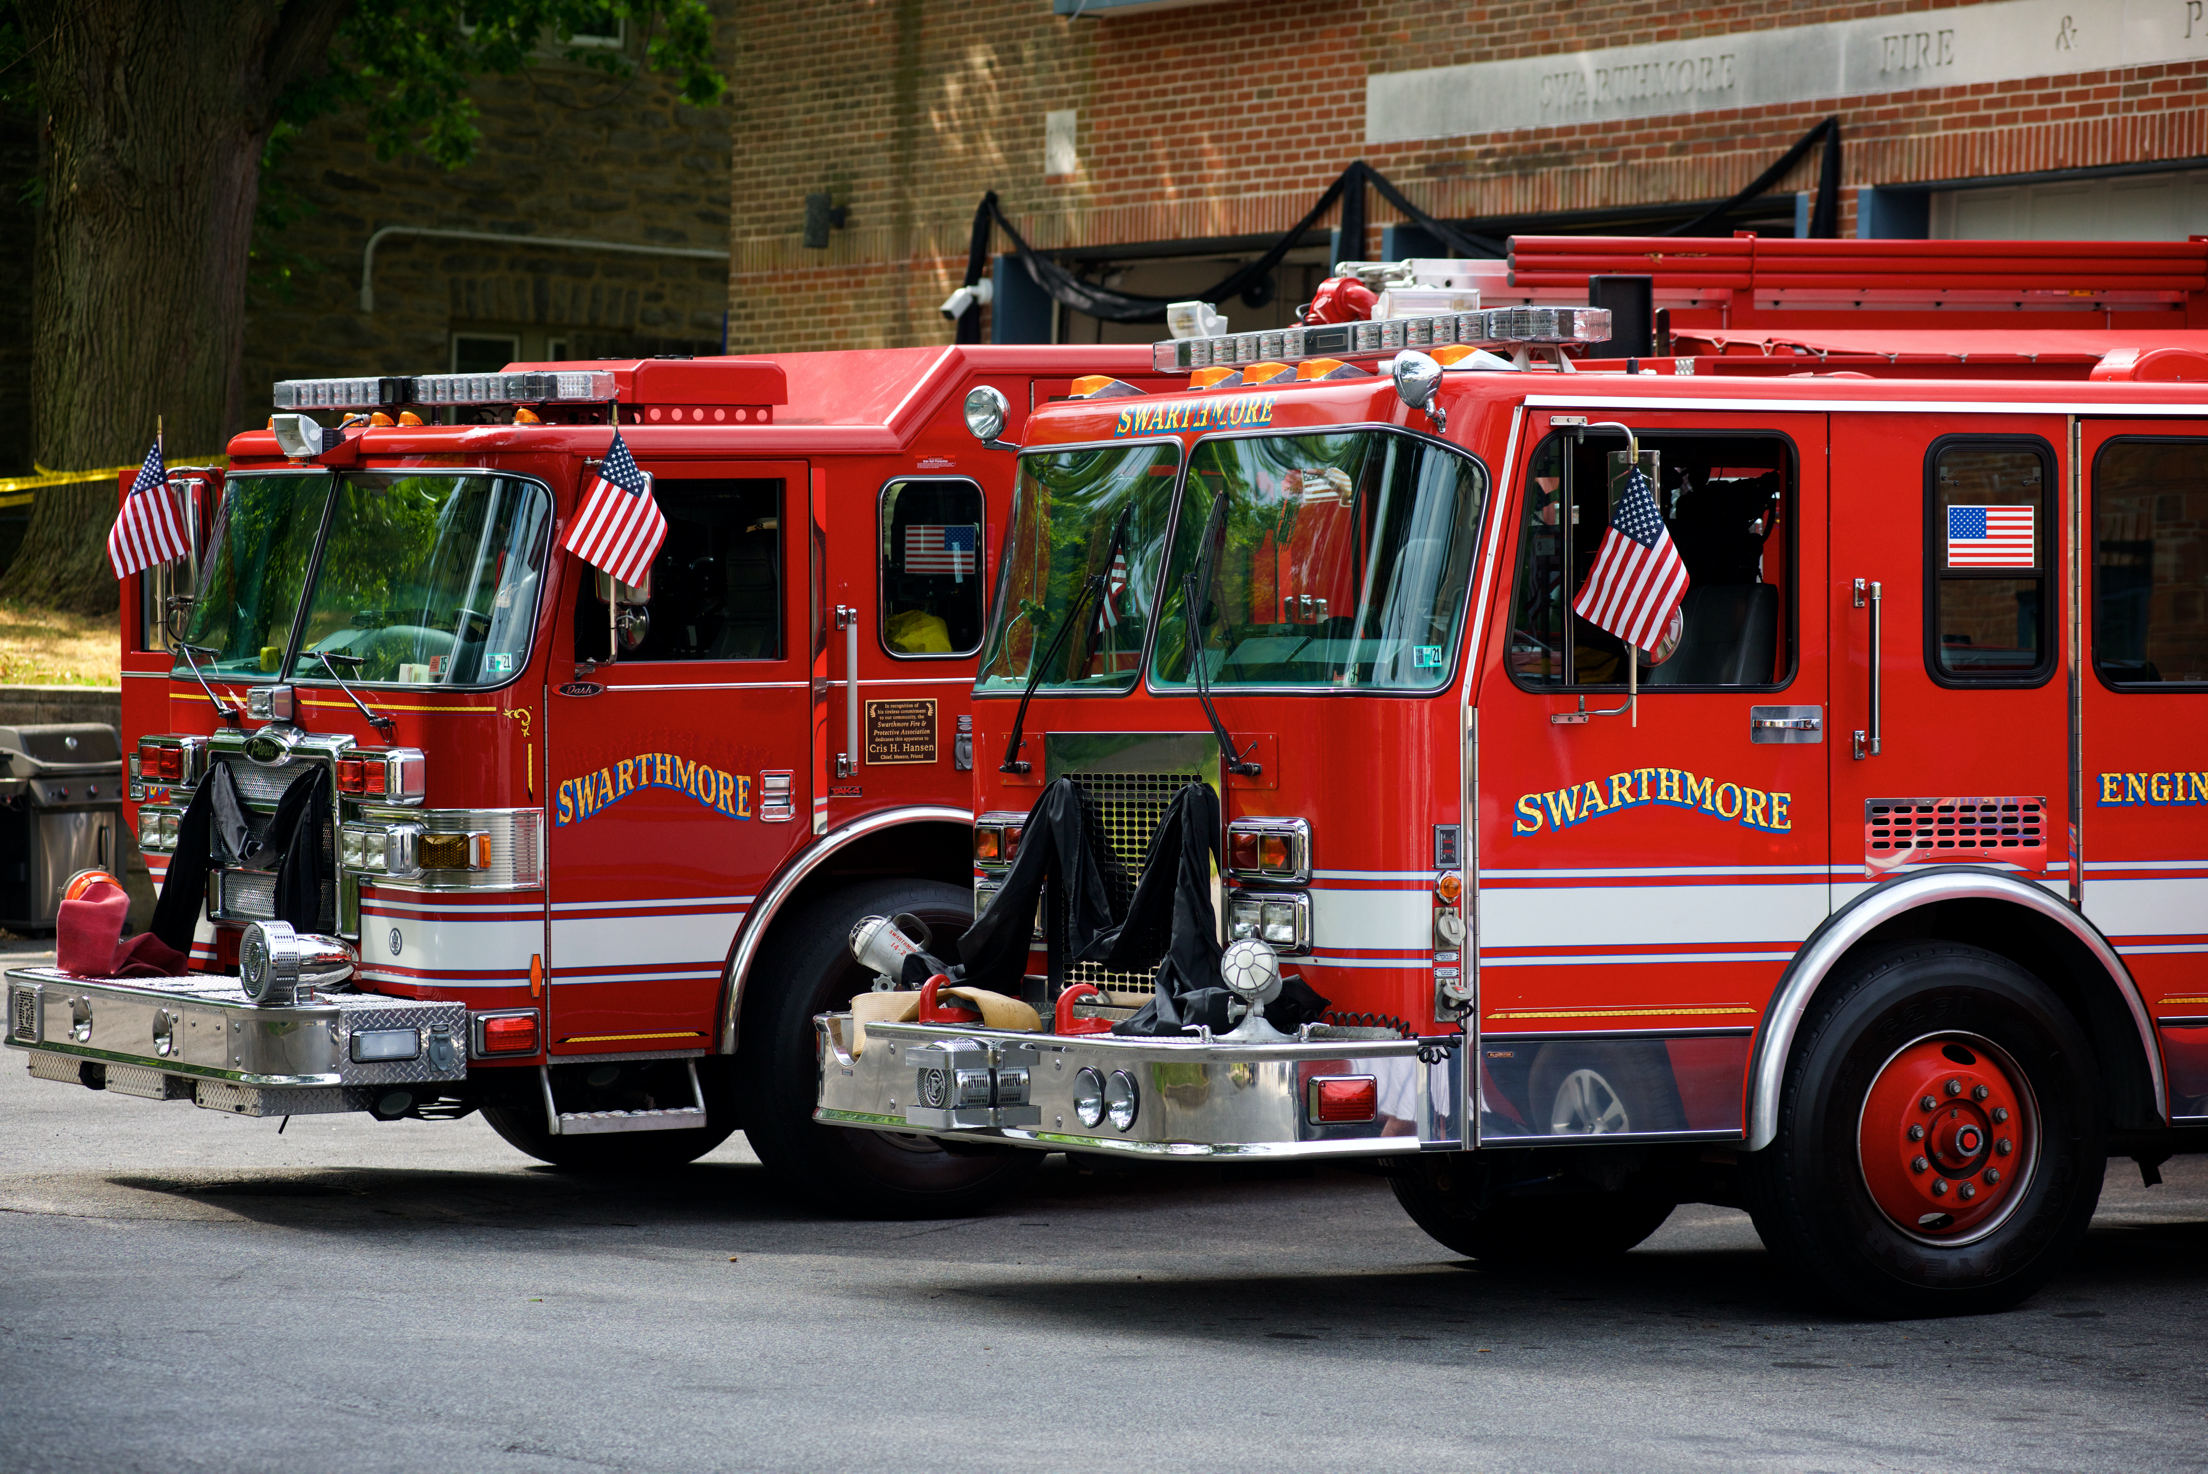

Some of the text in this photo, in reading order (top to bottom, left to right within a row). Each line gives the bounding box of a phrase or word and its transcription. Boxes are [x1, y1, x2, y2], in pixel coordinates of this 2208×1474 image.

[1539, 54, 1737, 108] SWARTHMORE
[1880, 29, 1955, 73] FIRE
[2056, 15, 2078, 52] &
[1115, 394, 1279, 437] SWARTHMORE
[1432, 647, 1441, 663] 21
[566, 685, 593, 694] Dash
[870, 744, 887, 752] Cris
[890, 744, 900, 752] H.
[556, 752, 752, 828] SWARTHMORE
[831, 787, 860, 795] TAK-4
[1512, 767, 1792, 837] SWARTHMORE
[2096, 771, 2208, 807] ENGIN
[1864, 1155, 2074, 1279] GOODYEAR
